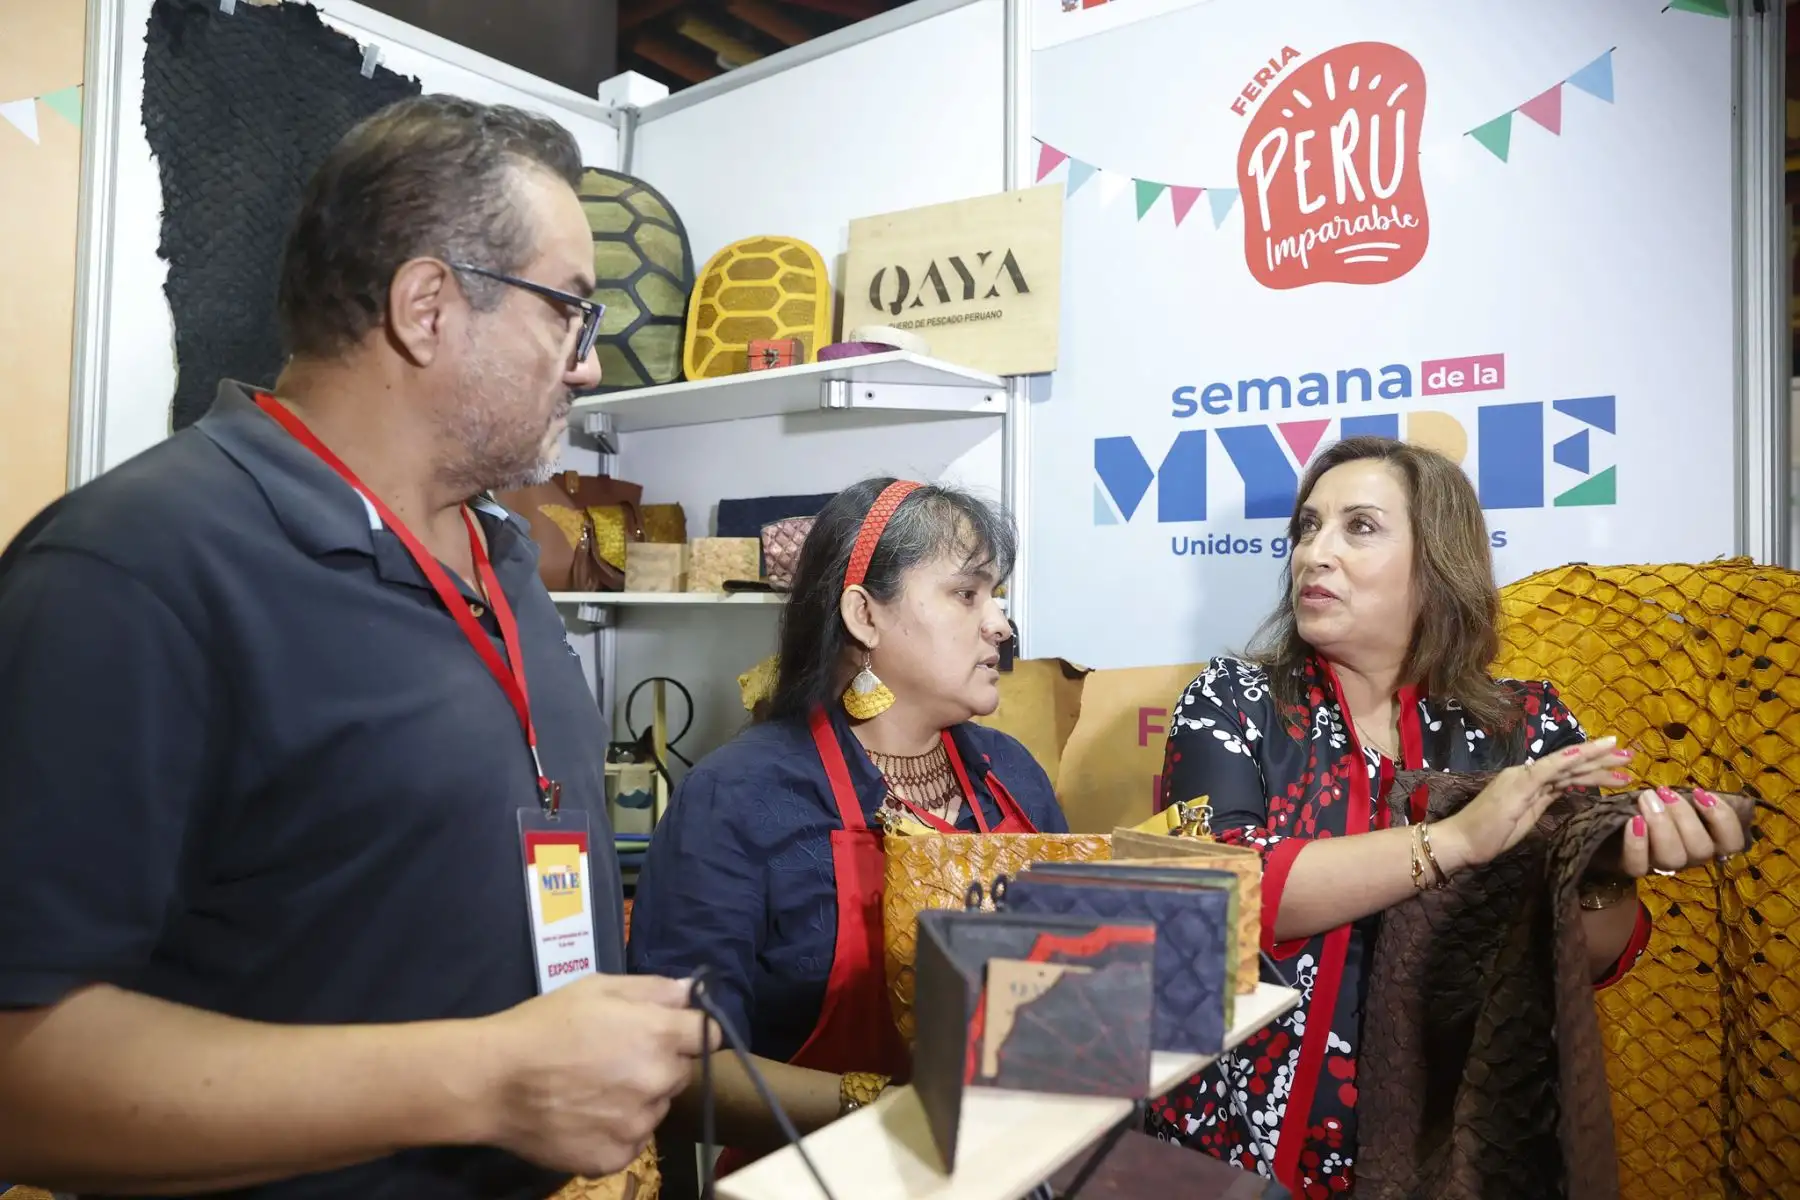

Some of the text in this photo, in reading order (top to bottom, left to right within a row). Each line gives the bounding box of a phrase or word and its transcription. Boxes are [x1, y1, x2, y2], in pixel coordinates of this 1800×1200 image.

[1230, 45, 1301, 116] FERIA
[1266, 204, 1419, 271] Imparable
[869, 248, 1030, 316] QAYA
[915, 319, 926, 328] DE
[964, 309, 1003, 322] PERUANO
[1172, 363, 1498, 418] semana de la
[1171, 533, 1263, 556] Unidos
[548, 957, 589, 977] EXPOSITOR
